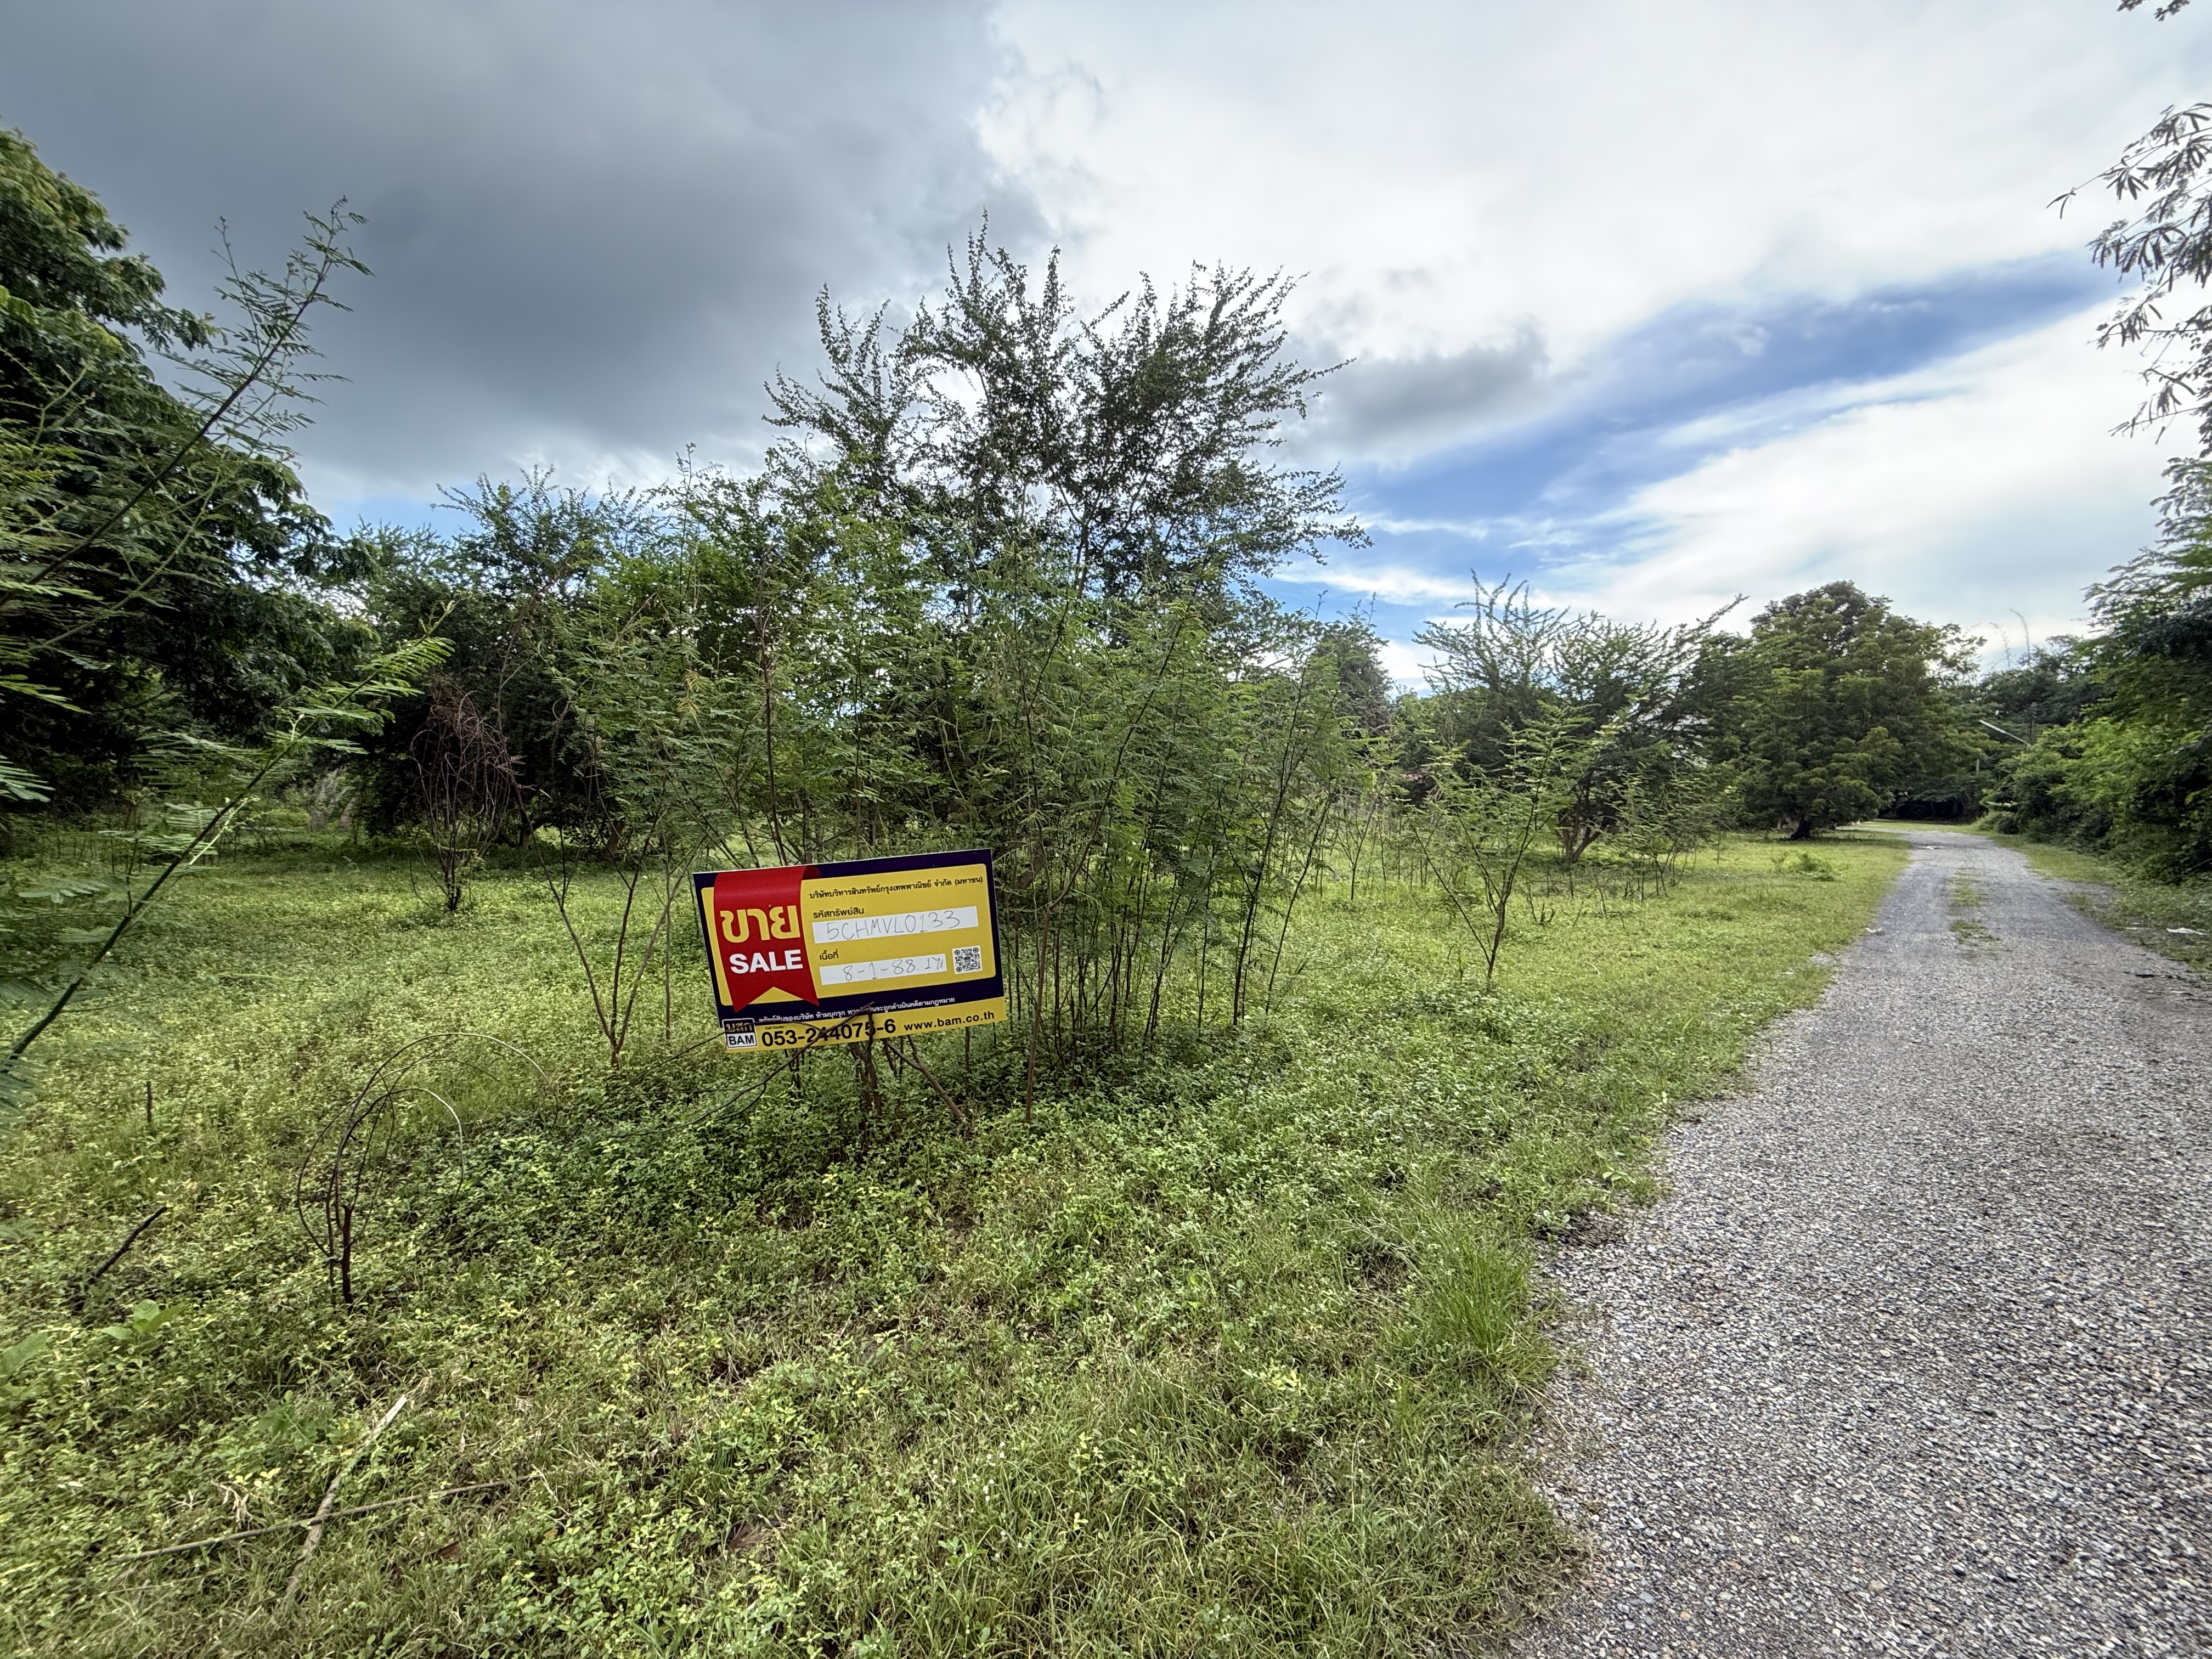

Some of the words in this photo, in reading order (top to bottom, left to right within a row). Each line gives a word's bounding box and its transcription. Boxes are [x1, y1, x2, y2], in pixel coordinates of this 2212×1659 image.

[809, 879, 932, 899] บริษัทบริหารสินทรัพย์กรุงเทพพาณิชย์
[934, 879, 952, 887] จำกัด
[955, 876, 984, 886] (มหาชน)
[813, 907, 864, 918] รหัสทรัพย์สิน
[720, 905, 800, 943] ขาย
[729, 949, 803, 974] SALE
[819, 949, 839, 961] เนื้อที่
[816, 1010, 845, 1019] ห้ามบุกรุก
[904, 1011, 995, 1031] www.bam.co.th
[729, 1035, 754, 1045] BAM
[762, 1019, 896, 1047] 053-244075-6
